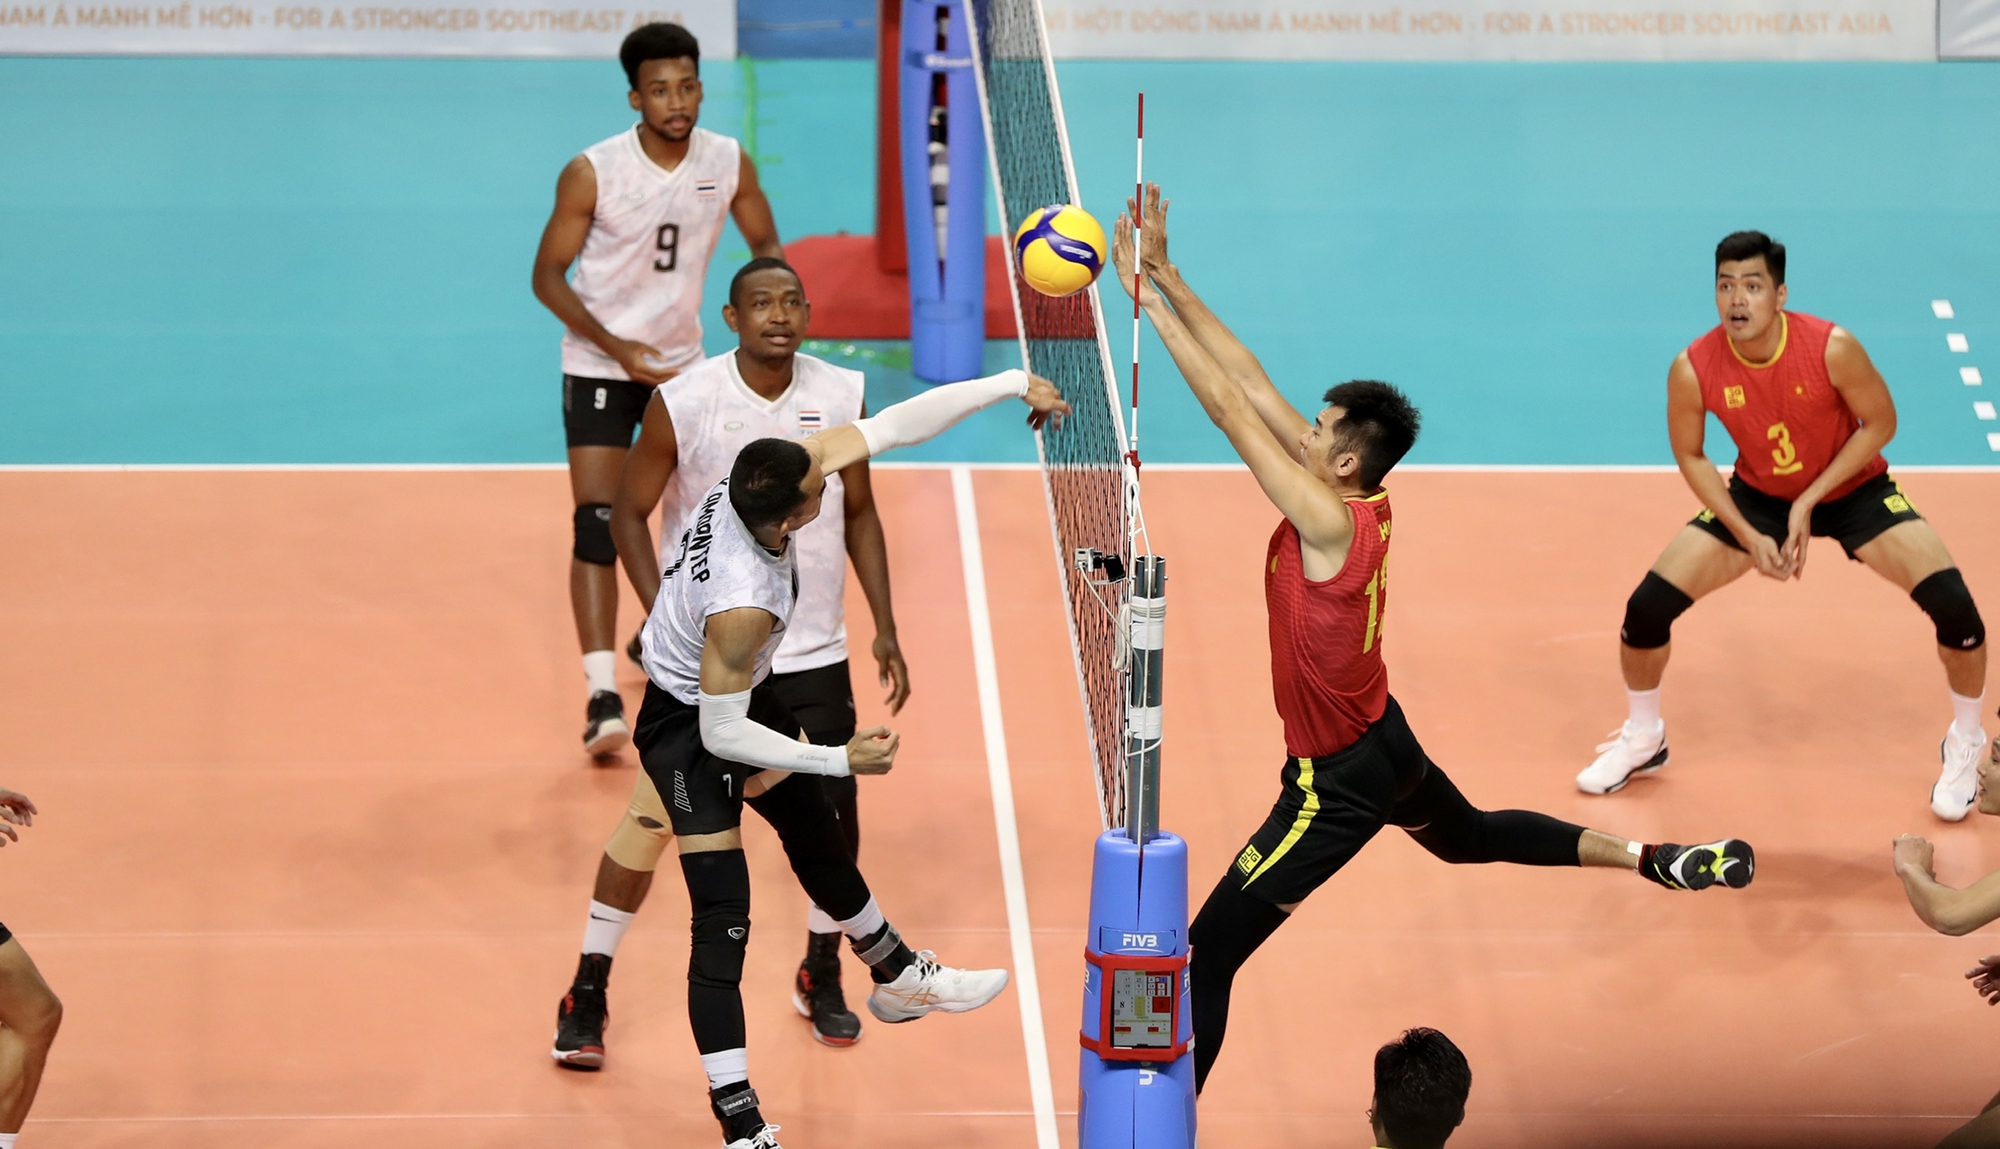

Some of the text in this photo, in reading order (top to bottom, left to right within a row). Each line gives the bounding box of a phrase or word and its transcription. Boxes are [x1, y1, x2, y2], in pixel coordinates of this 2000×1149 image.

[274, 7, 323, 29] FOR
[329, 8, 346, 28] A
[352, 8, 480, 31] STRONGER
[486, 9, 625, 33] SOUTHEAST
[1207, 13, 1261, 32] NAM
[1483, 12, 1532, 34] FOR
[1538, 13, 1556, 33] A
[1560, 12, 1687, 35] STRONGER
[1692, 11, 1832, 35] SOUTHEAST
[1837, 13, 1893, 35] ASIA
[654, 222, 680, 272] 9
[594, 387, 607, 410] 9
[1767, 421, 1796, 467] 3
[722, 773, 732, 797] 7
[1122, 933, 1158, 947] FIVB
